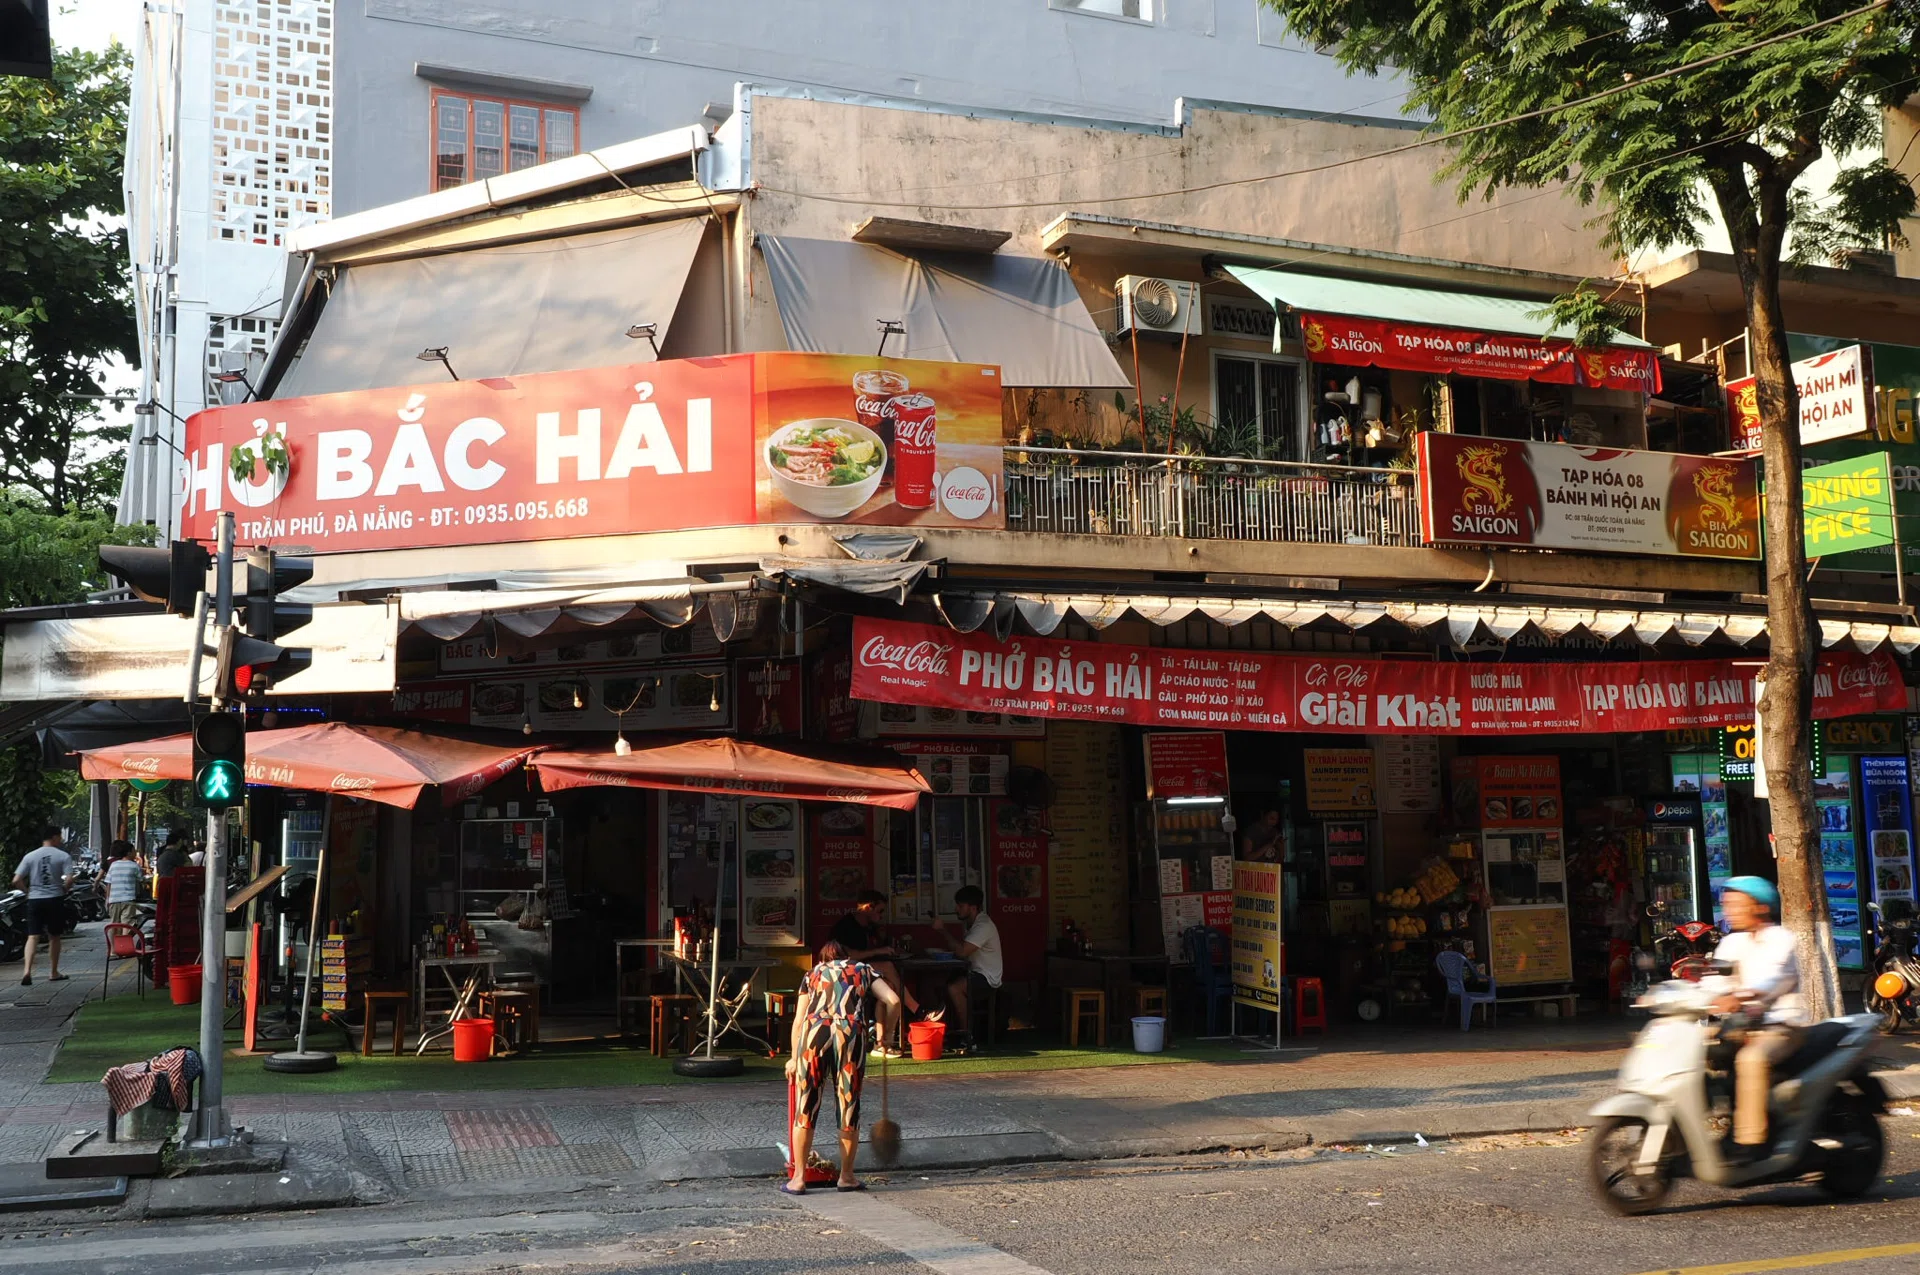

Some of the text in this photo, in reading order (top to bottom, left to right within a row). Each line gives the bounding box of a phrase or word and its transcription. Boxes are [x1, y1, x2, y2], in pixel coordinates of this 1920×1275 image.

[1348, 330, 1364, 339] BIA
[1330, 337, 1384, 355] SAIGON
[1395, 333, 1576, 365] TẠP HÓA 08 BÁNH MÌ HỘI AN
[1839, 364, 1856, 389] MÌ
[1802, 397, 1853, 428] HỘI AN
[316, 393, 507, 501] BẮC
[535, 381, 712, 485] HẢI
[1561, 467, 1644, 489] TẠP HÓA 08
[1475, 504, 1495, 515] BIA
[1546, 486, 1661, 513] BÁNH MÌ HỘI AN
[242, 514, 286, 541] TRẦN
[290, 510, 330, 538] PHÚ,
[334, 510, 362, 533] ĐÀ
[430, 510, 459, 530] ĐT:
[463, 497, 588, 525] 0935.095.668
[1451, 514, 1519, 535] SAIGON
[1709, 521, 1728, 532] BIA
[1690, 530, 1748, 550] SAIGON
[860, 635, 956, 676] Coca-Cola
[1160, 657, 1174, 669] TÁI
[1184, 657, 1199, 670] TÁI
[880, 675, 928, 688] Real Magic
[959, 642, 1152, 701] PHỞ BẮC HẢI
[1159, 672, 1173, 685] ÁP
[1202, 676, 1229, 689] NƯỚC
[1305, 663, 1369, 688] Cà Phê
[1470, 672, 1523, 689] NƯỚC MÍA
[1583, 684, 1620, 716] TẠP
[1622, 678, 1666, 710] HÓA
[1669, 682, 1688, 708] 08
[1695, 675, 1745, 707] BÁNH
[1813, 673, 1834, 698] AN
[989, 697, 1004, 708] 185
[1006, 697, 1028, 709] TRẦN
[1030, 699, 1049, 711] PHÚ
[1158, 691, 1178, 702] GẦU
[1186, 691, 1207, 704] PHỞ
[1209, 692, 1229, 705] XÀO
[1246, 695, 1264, 707] XÀO
[1300, 691, 1461, 727] Giải Khát
[1472, 694, 1556, 714] DỪA XIÊM LẠNH
[1159, 708, 1179, 720] CƠM
[1180, 710, 1207, 721] RANG
[1209, 711, 1229, 722] DƯA
[1248, 710, 1270, 724] MIẾN
[1272, 711, 1287, 725] GÀ
[1471, 721, 1480, 729] 08
[271, 763, 295, 783] HẢI
[1726, 763, 1749, 776] FREE
[1667, 803, 1693, 818] pepsi
